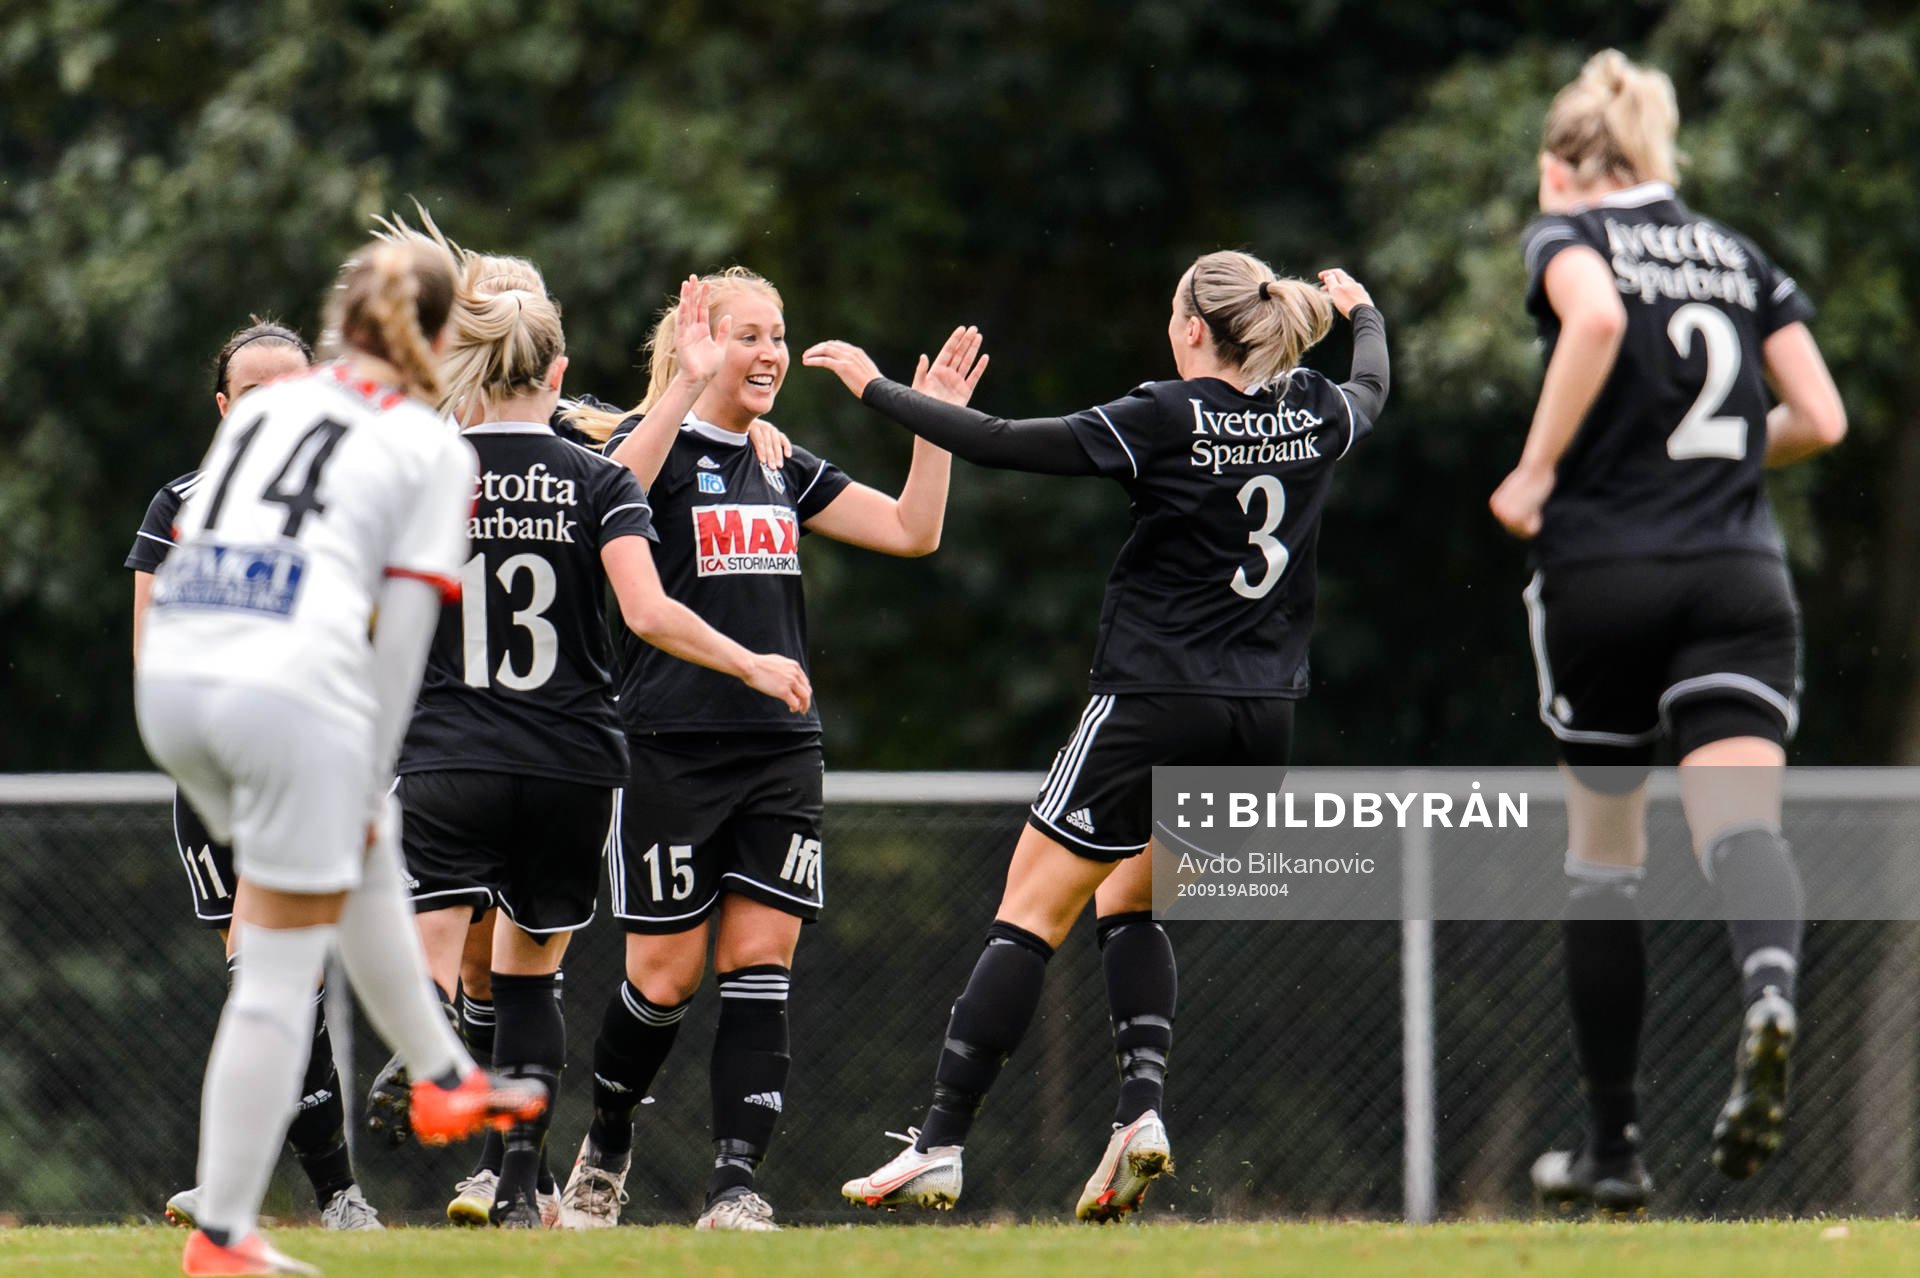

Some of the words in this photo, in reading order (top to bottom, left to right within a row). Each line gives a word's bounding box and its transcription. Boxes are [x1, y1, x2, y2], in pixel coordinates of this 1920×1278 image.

[1666, 302, 1749, 461] 2
[1188, 398, 1323, 437] Ivetofta
[203, 414, 349, 539] 14
[1191, 432, 1321, 475] Sparbank
[701, 558, 726, 572] ICA
[1229, 474, 1289, 600] 3
[460, 551, 558, 692] 13
[186, 843, 228, 900] 11
[643, 843, 695, 902] 15
